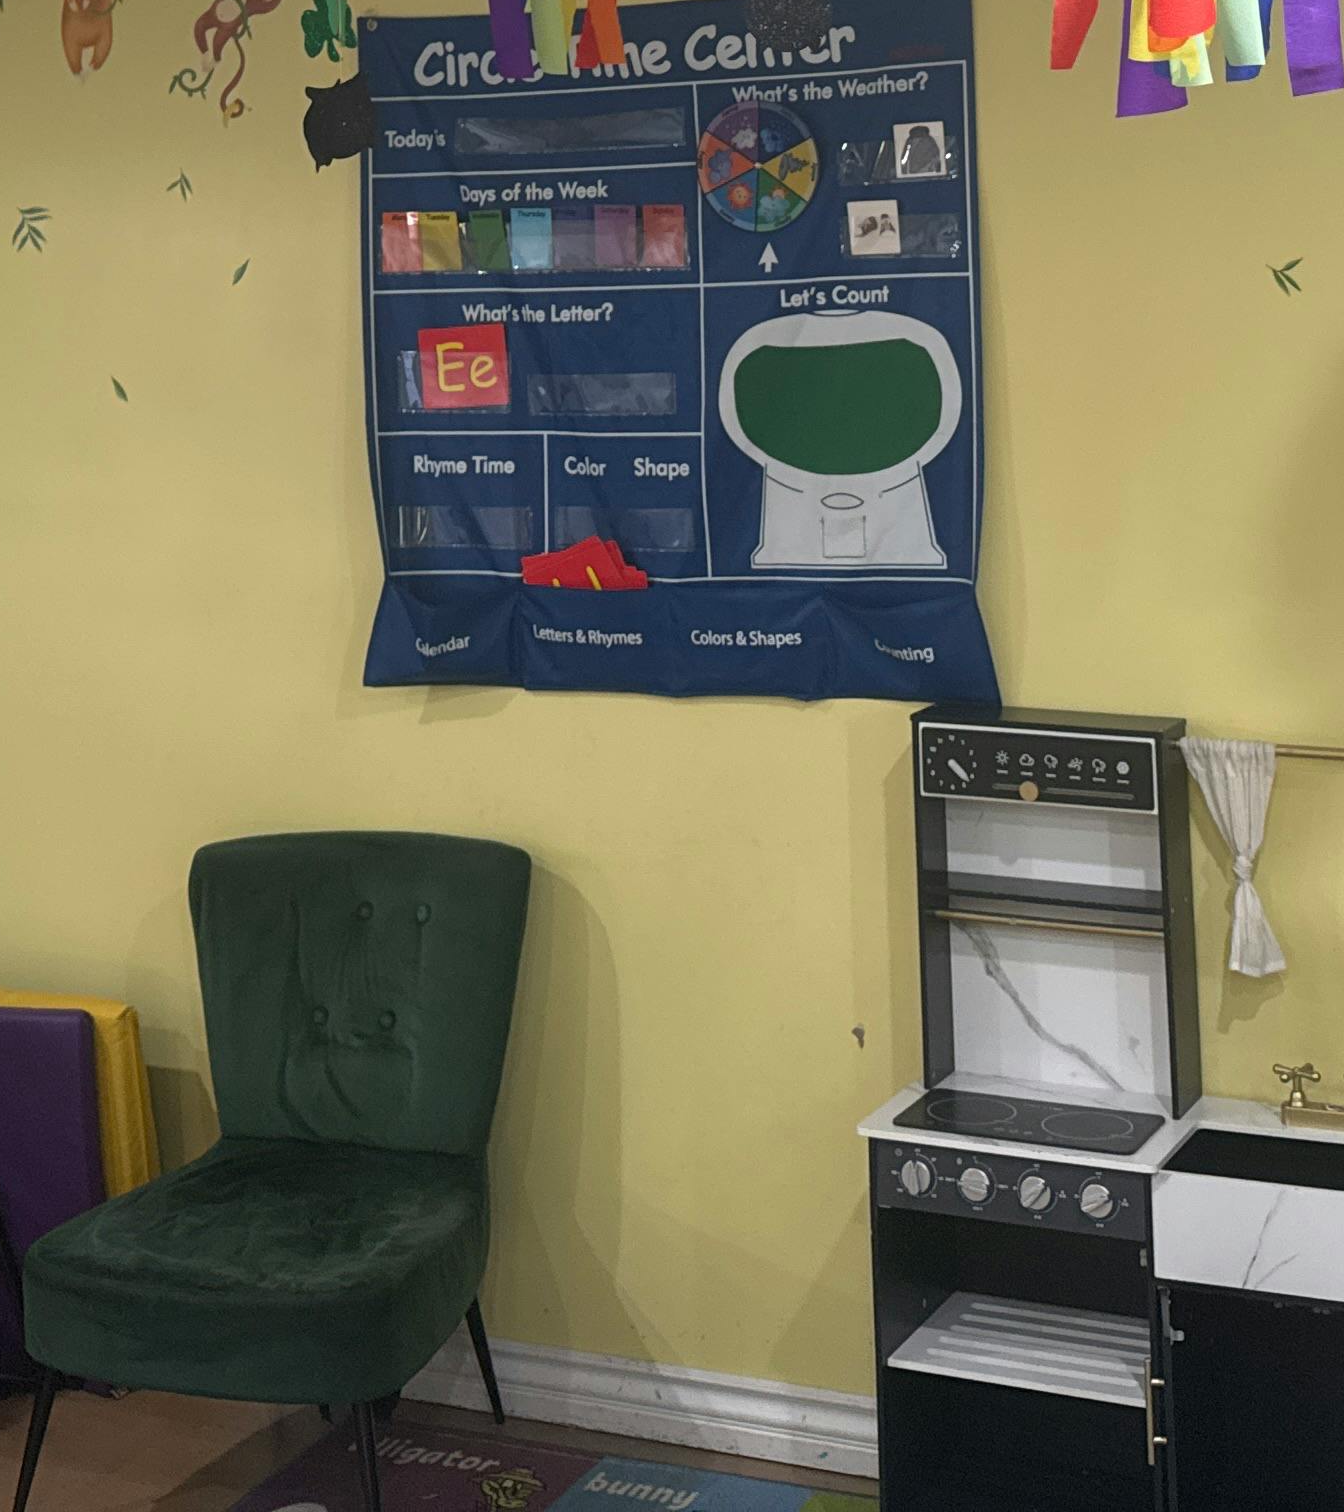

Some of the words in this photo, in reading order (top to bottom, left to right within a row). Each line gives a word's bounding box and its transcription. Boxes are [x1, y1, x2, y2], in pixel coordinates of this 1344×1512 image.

[732, 85, 799, 104] What's
[803, 82, 833, 101] the
[838, 71, 929, 99] Weather?
[384, 128, 433, 152] Today
[434, 129, 446, 147] is
[460, 185, 496, 207] Days
[502, 183, 522, 201] of
[525, 181, 554, 200] the
[558, 179, 608, 199] Week
[780, 286, 827, 308] Let's
[832, 284, 890, 305] Count
[462, 304, 520, 323] What's
[522, 304, 546, 323] the
[550, 302, 614, 323] Letter?
[435, 342, 497, 392] Ee
[413, 455, 467, 478] Rhyme
[471, 456, 515, 474] Time
[563, 456, 606, 476] Color
[633, 458, 690, 481] Shape
[532, 623, 574, 643] Letters
[576, 629, 587, 644] &
[588, 630, 643, 649] Rhymes
[690, 629, 734, 646] Colors
[735, 630, 747, 646] &
[748, 630, 802, 649] Shapes
[584, 1472, 700, 1507] bunny
